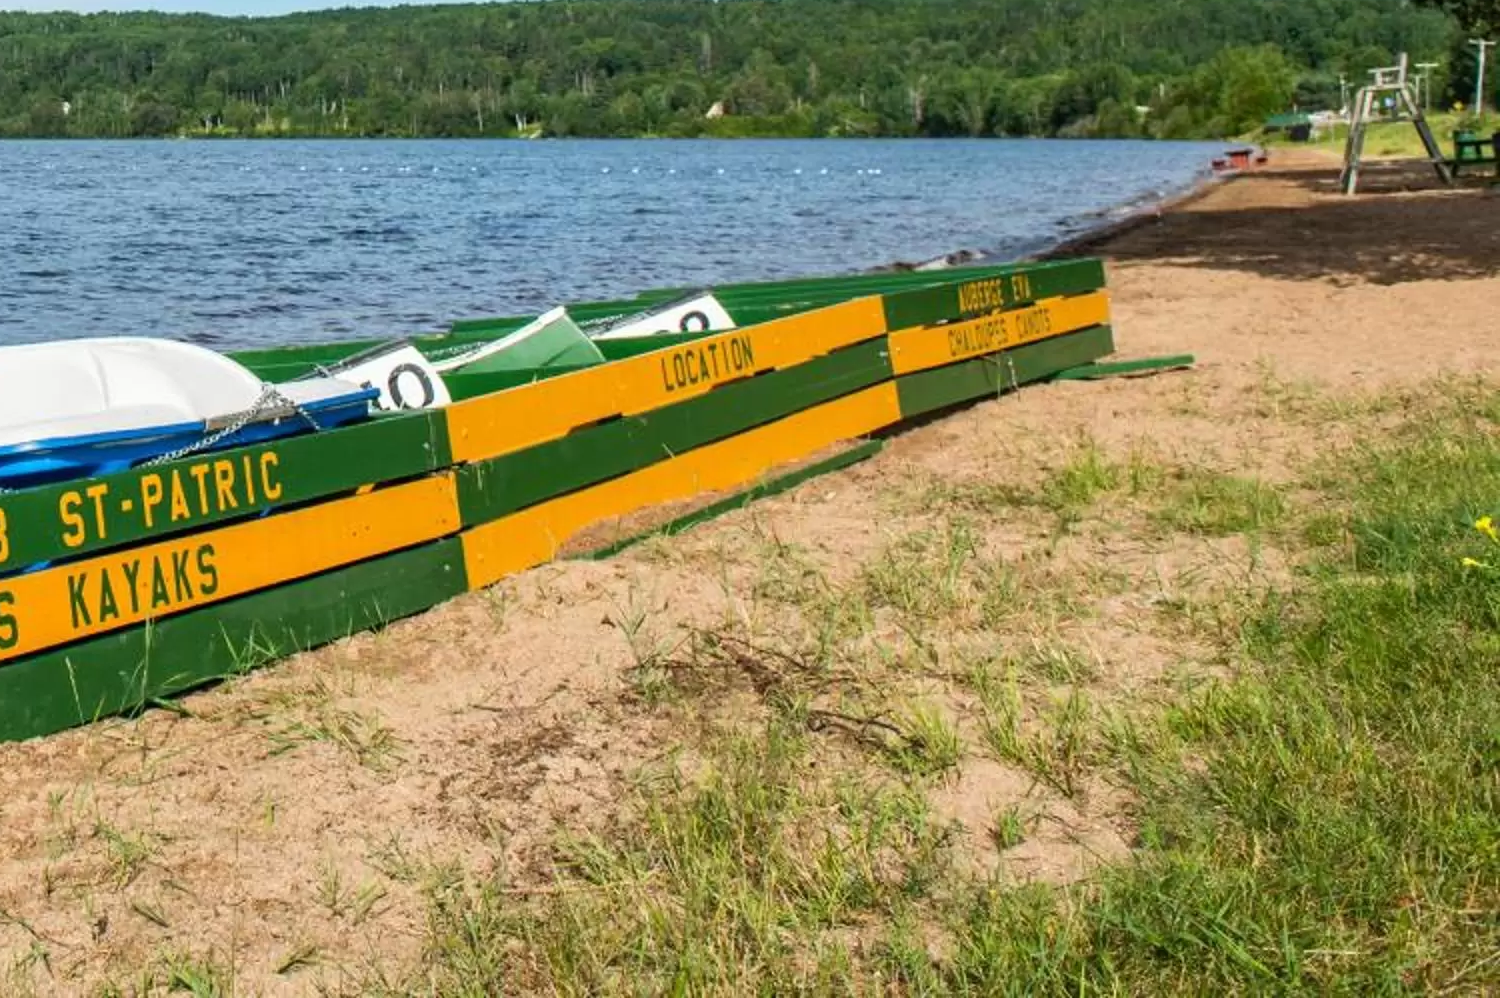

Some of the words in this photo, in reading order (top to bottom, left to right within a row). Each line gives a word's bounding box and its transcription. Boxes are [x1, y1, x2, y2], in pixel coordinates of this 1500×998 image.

[660, 336, 754, 391] LOCATION
[58, 451, 282, 548] ST-PATRIC
[67, 543, 220, 630] KAYAKS
